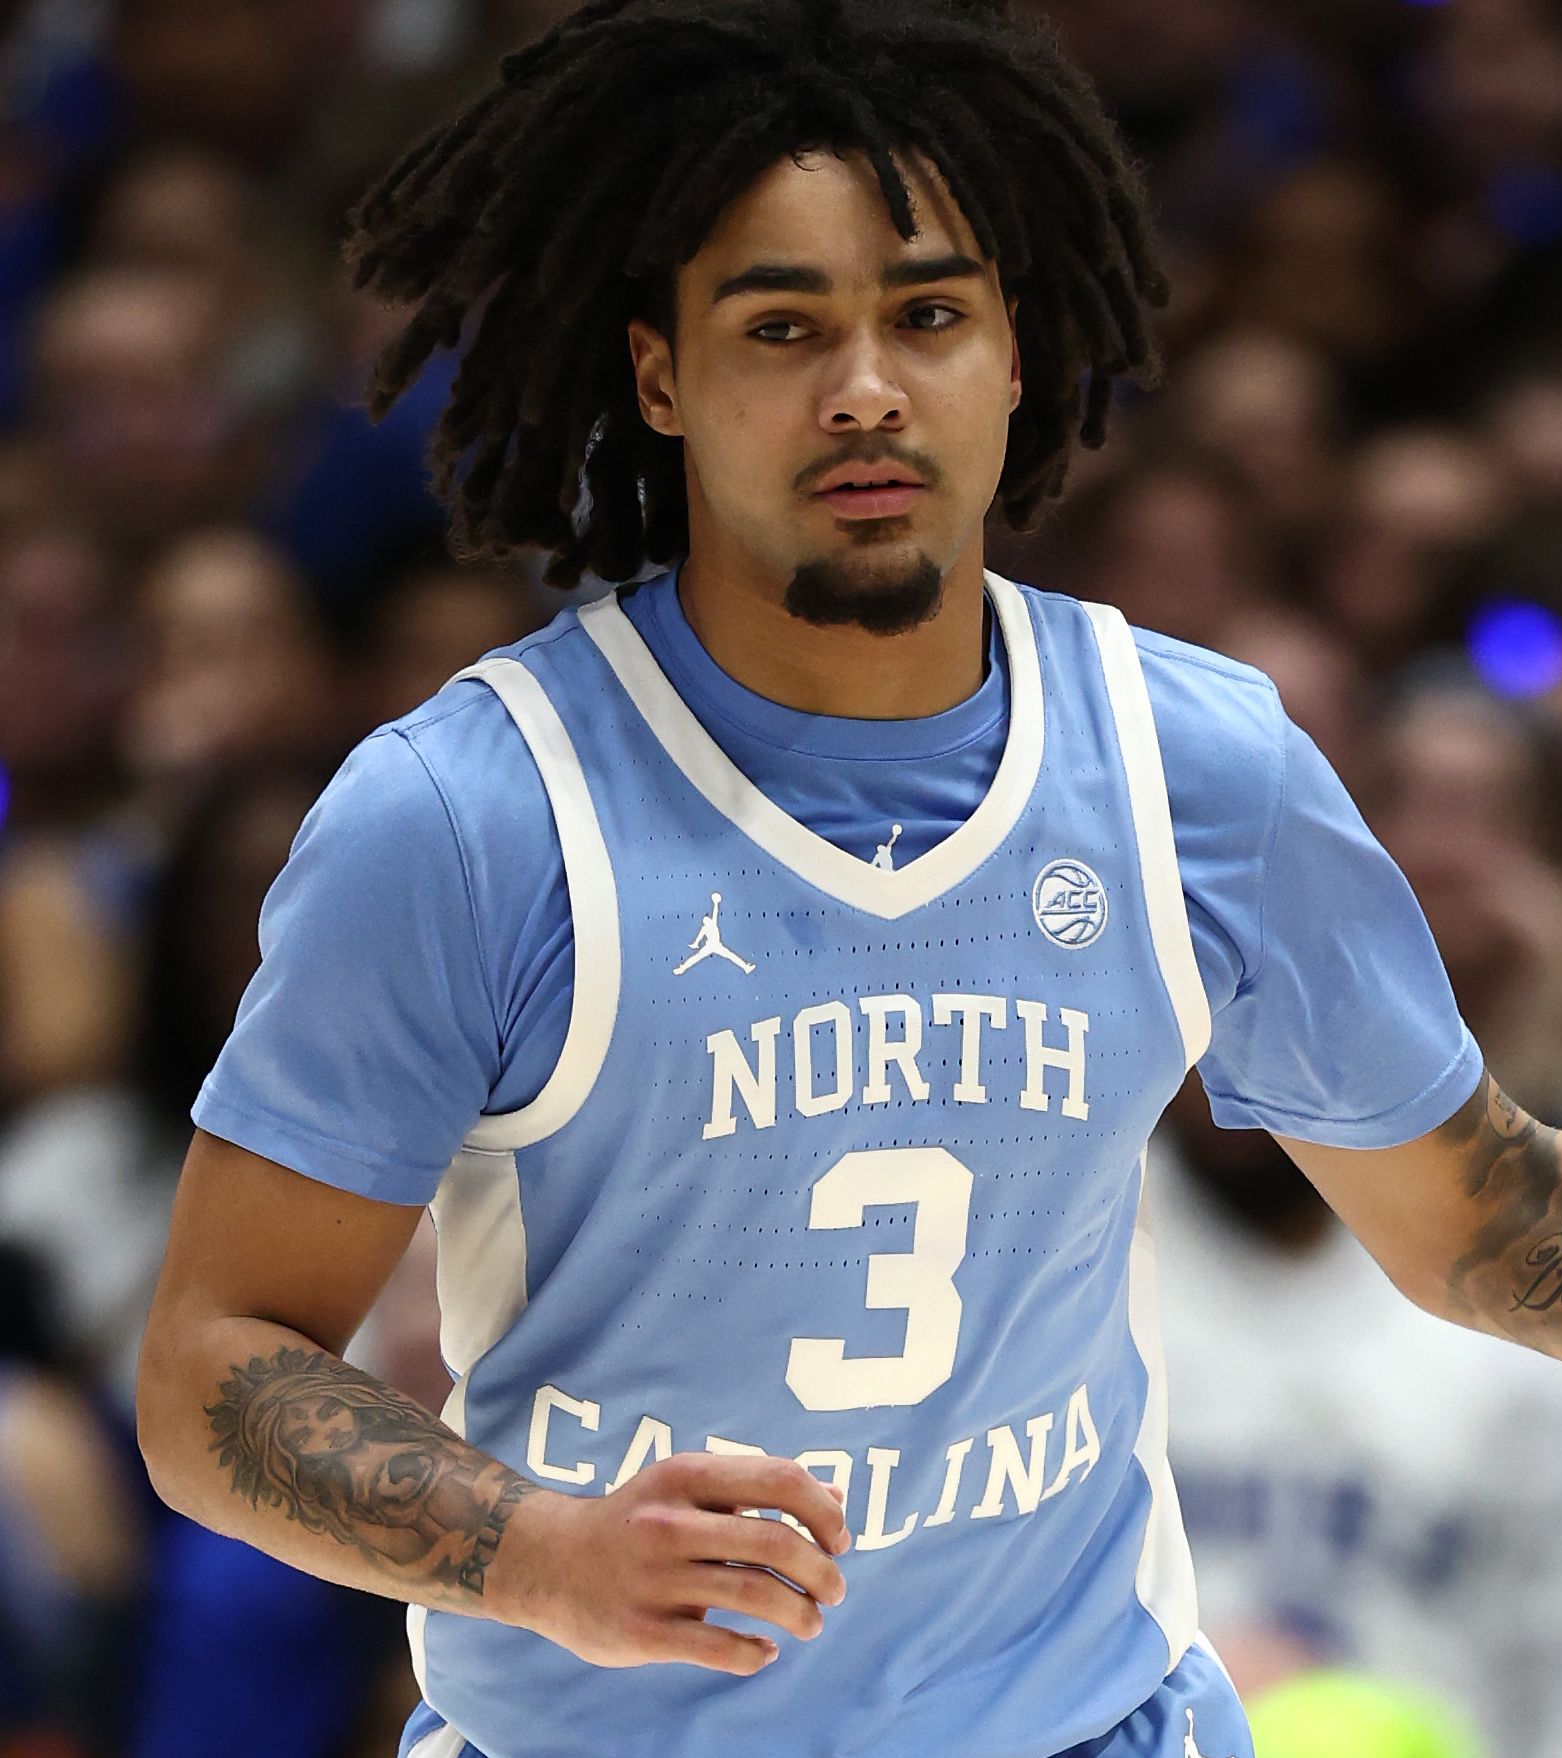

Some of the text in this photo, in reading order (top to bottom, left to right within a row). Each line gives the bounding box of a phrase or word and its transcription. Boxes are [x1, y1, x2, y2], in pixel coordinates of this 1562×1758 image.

[1048, 890, 1099, 909] ACC
[703, 995, 1090, 1140] NORTH
[786, 1148, 974, 1411] 3
